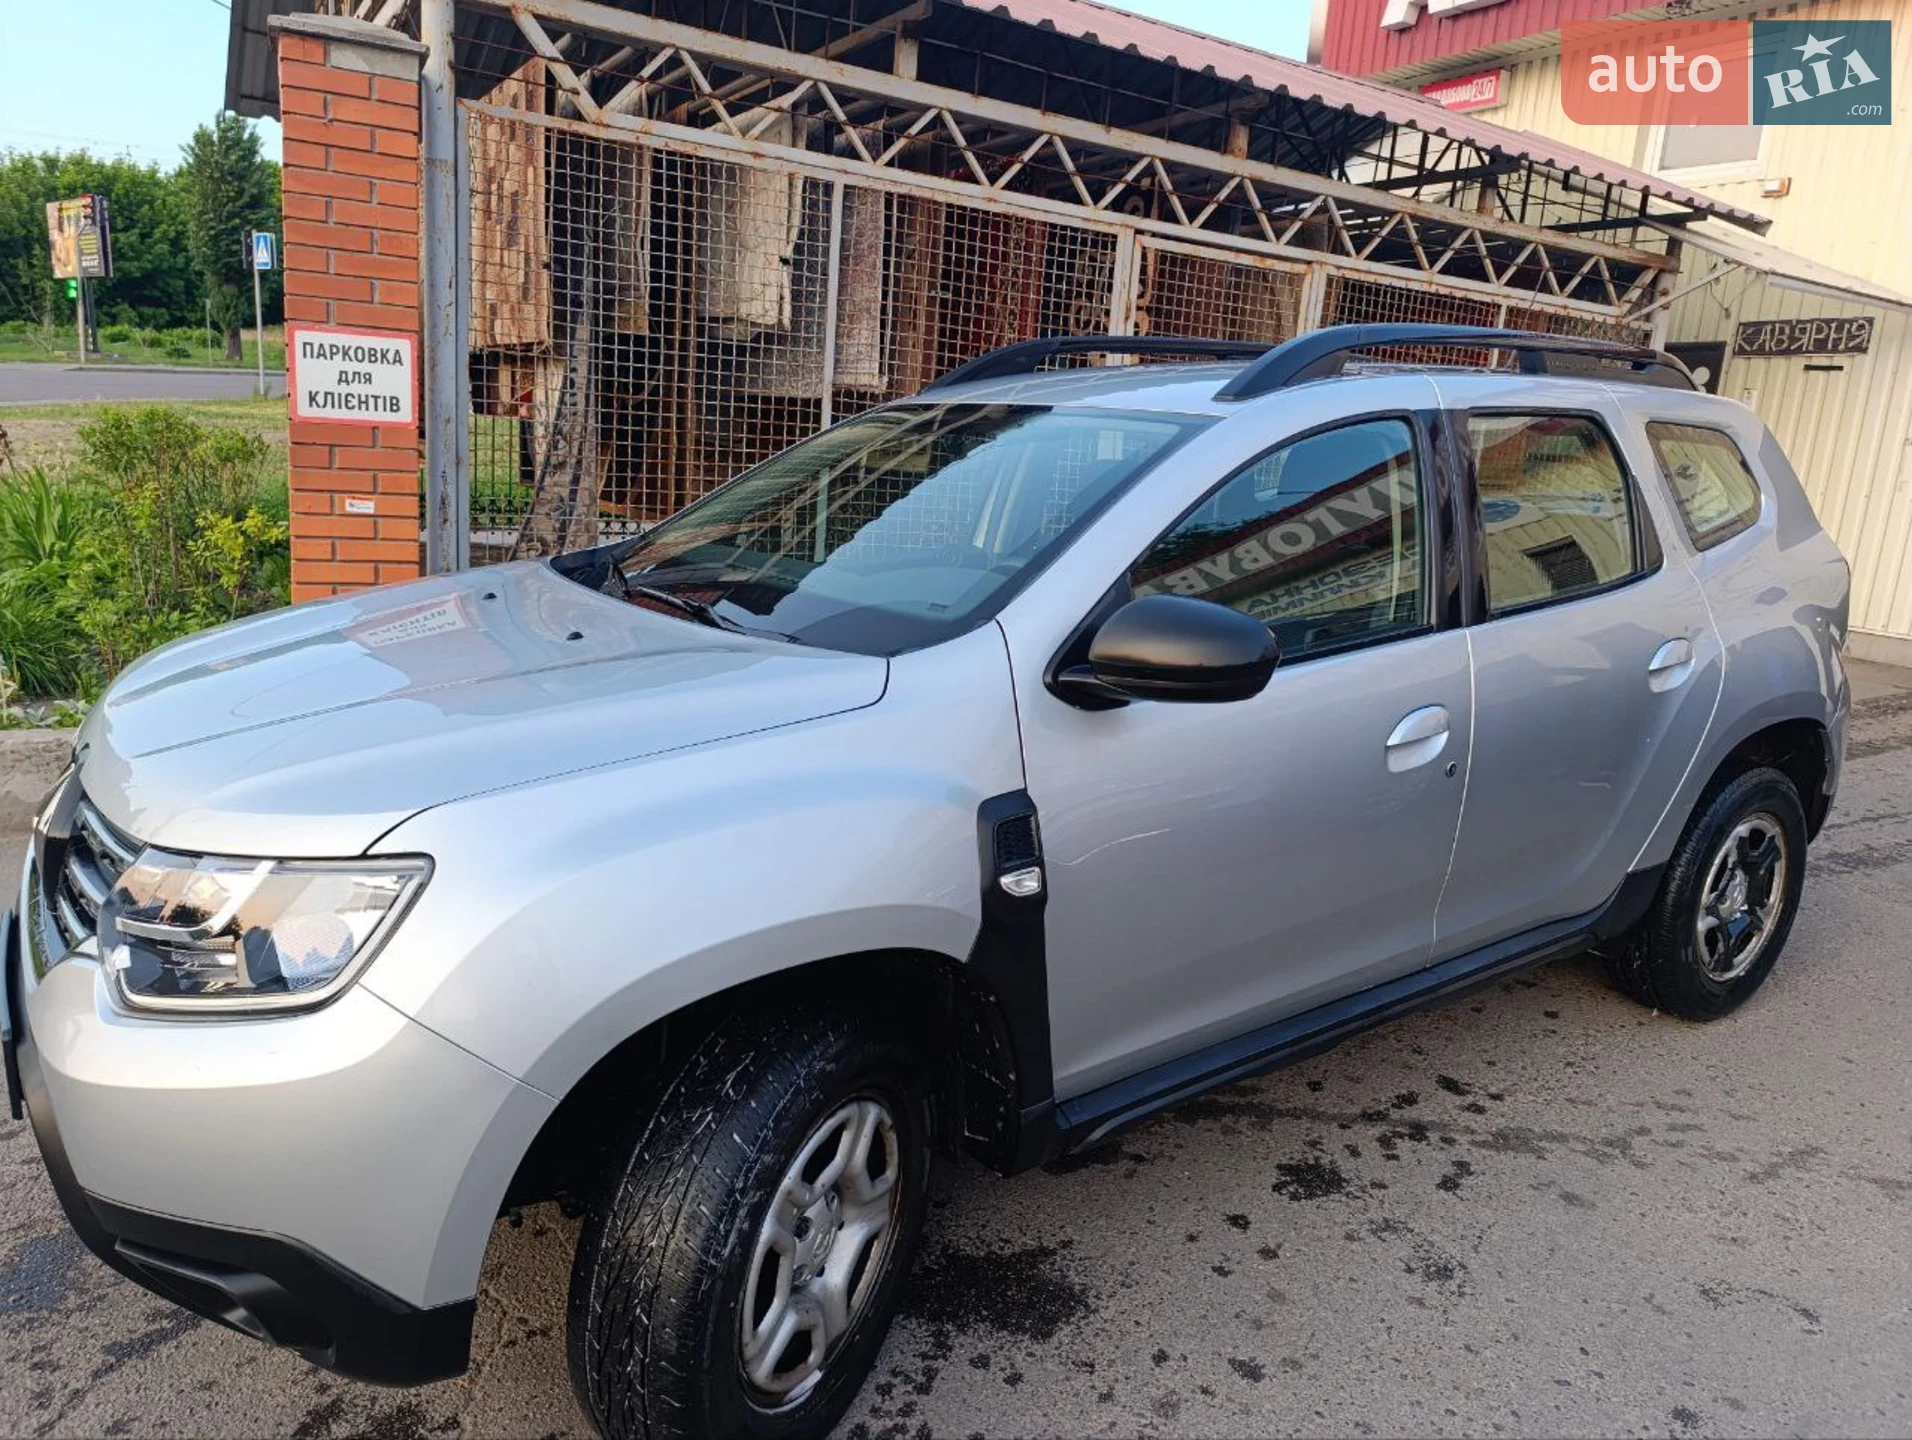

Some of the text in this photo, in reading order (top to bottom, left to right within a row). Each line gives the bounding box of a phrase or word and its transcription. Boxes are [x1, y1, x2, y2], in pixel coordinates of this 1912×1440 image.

[1735, 319, 1869, 351] КАВ'ЯРНЯ
[302, 341, 404, 366] ПАРКОВКА
[308, 390, 401, 413] КЛІЄНТІВ
